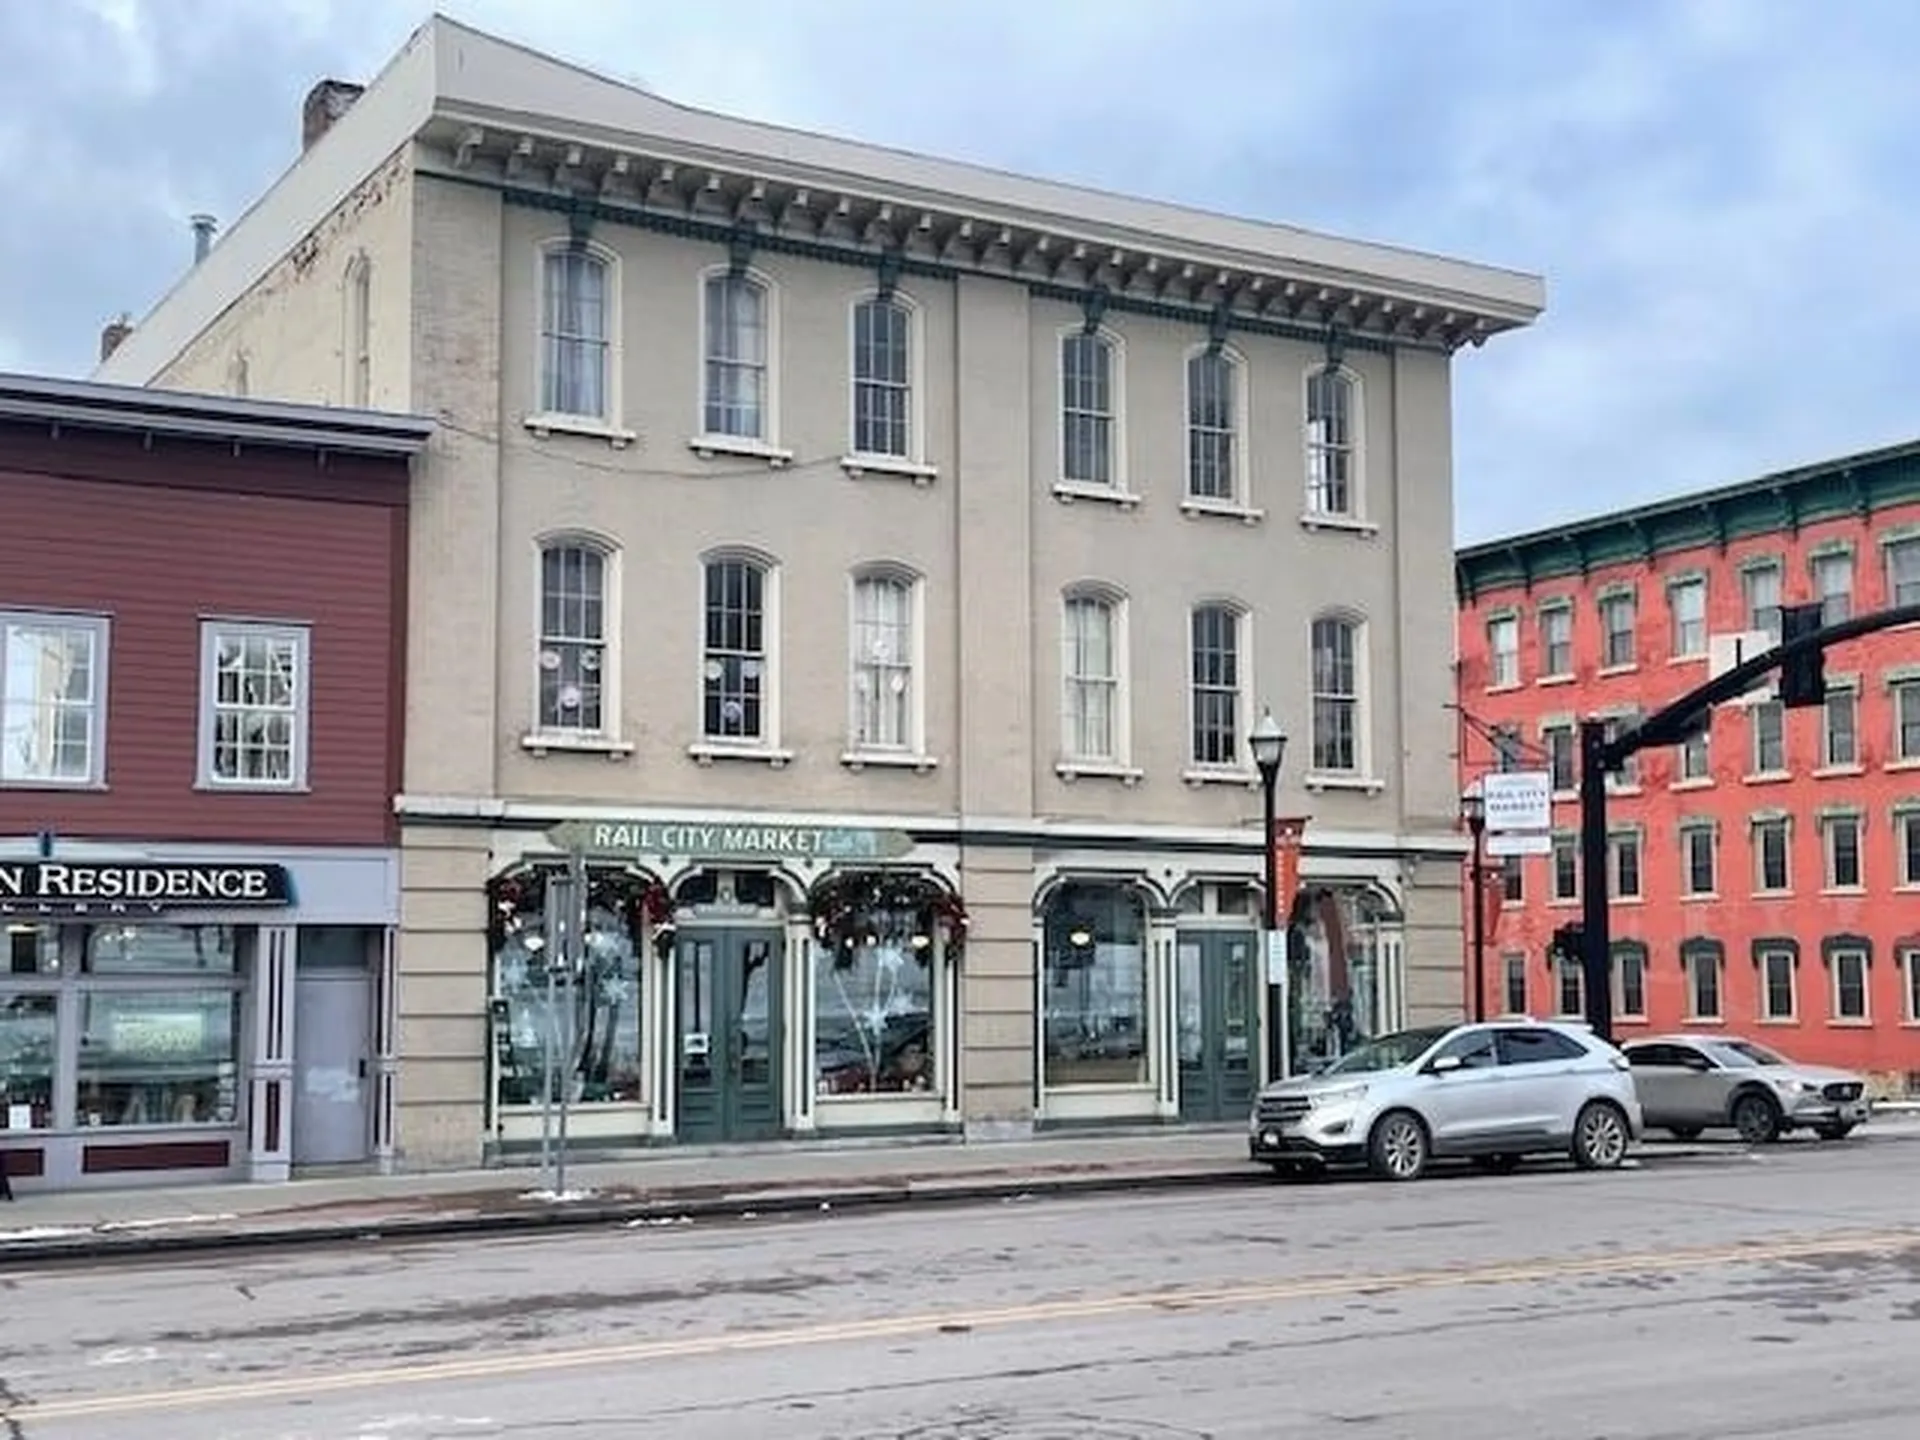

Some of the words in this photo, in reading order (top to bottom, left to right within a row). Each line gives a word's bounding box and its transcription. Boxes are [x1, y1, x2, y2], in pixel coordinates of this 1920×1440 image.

[594, 824, 654, 848] RAIL
[661, 826, 715, 849] CITY
[722, 828, 822, 851] MARKET
[36, 864, 268, 898] RESIDENCE
